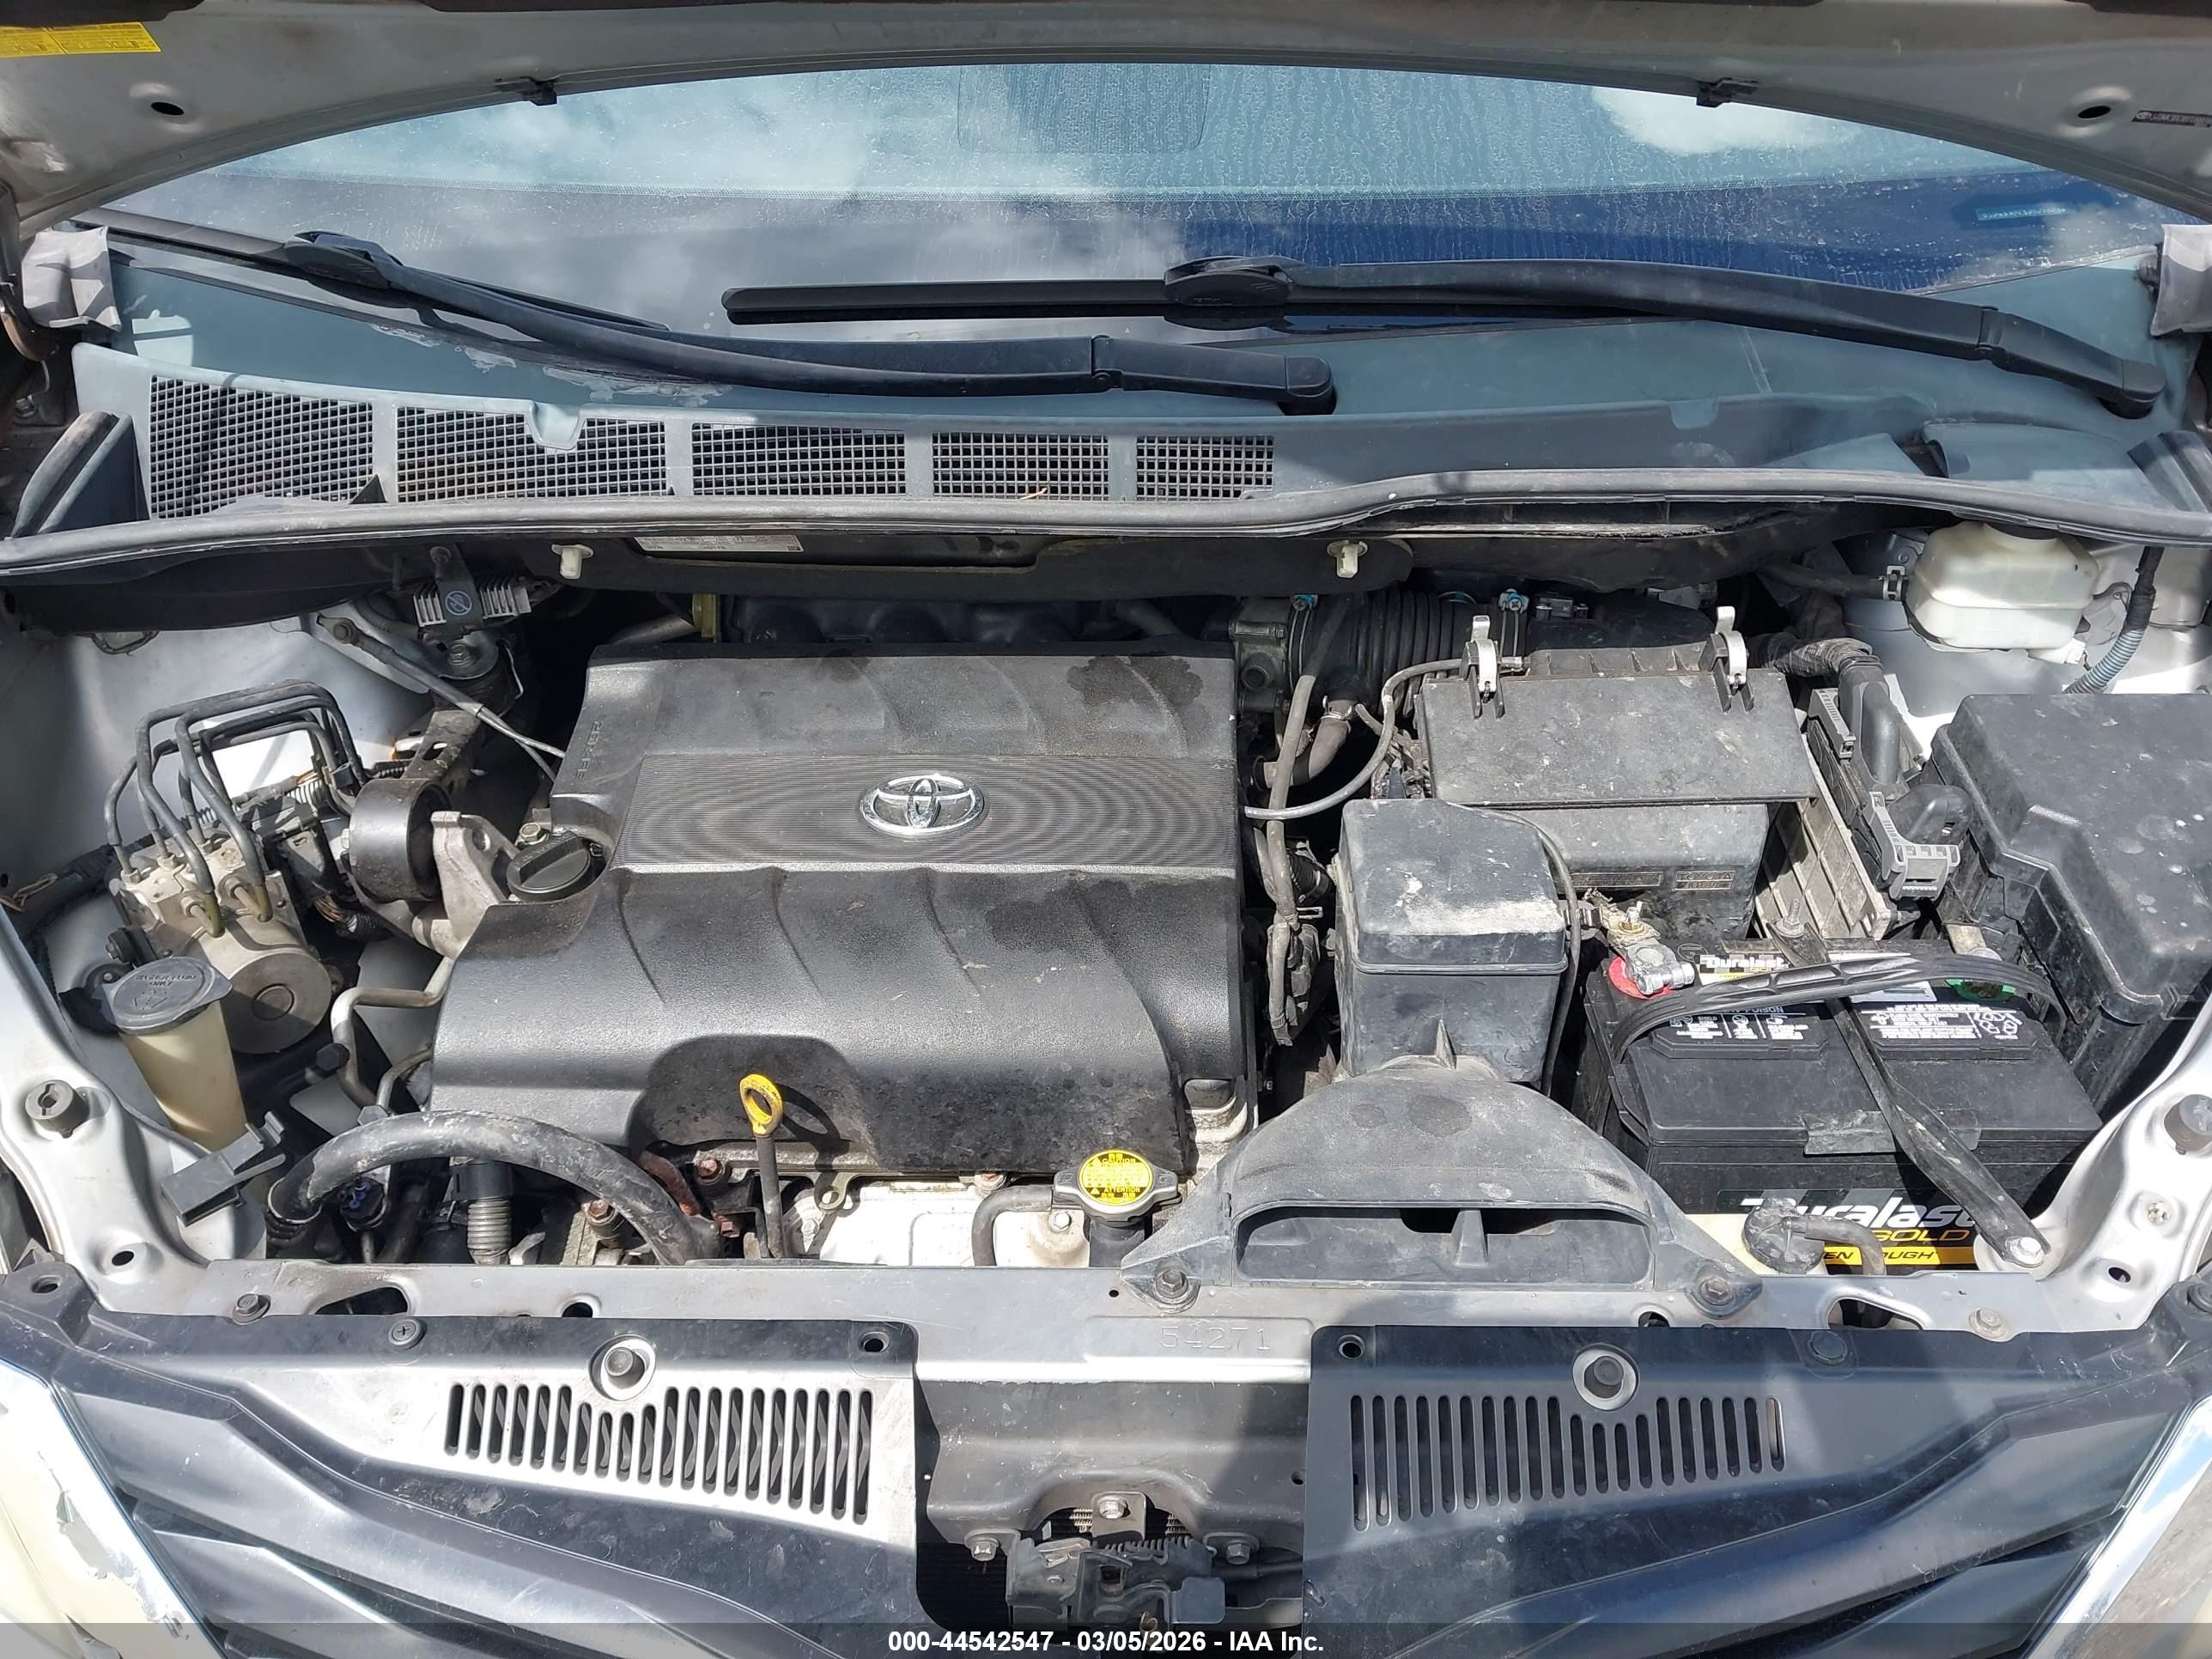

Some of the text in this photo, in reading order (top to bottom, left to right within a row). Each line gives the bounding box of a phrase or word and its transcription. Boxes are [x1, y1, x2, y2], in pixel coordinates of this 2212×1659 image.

[1701, 957, 1785, 969] Duralast
[1740, 1197, 1976, 1228] ralas
[1872, 1229, 1971, 1242] GOLD
[1160, 1324, 1270, 1351] 54271
